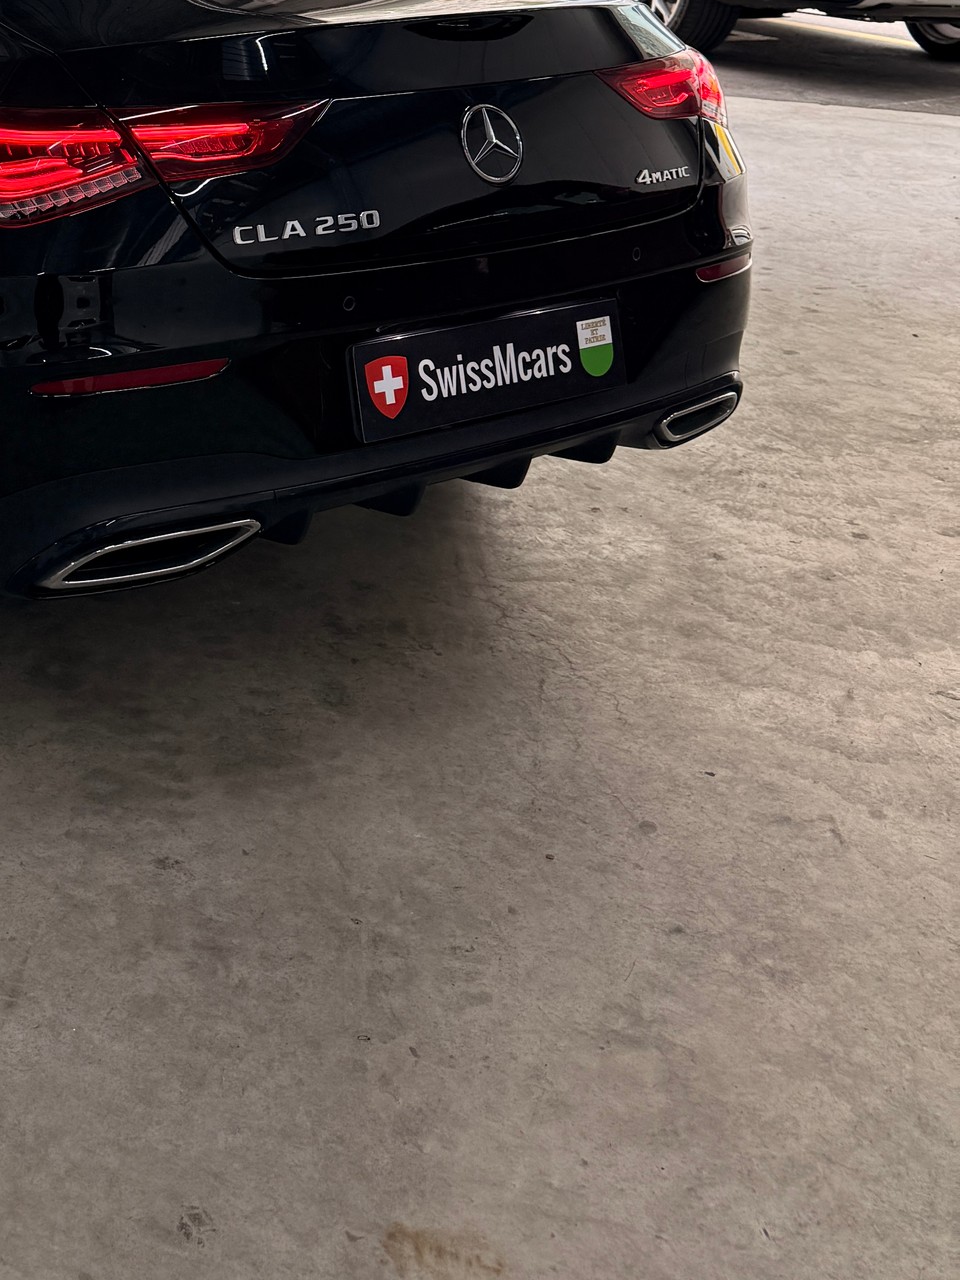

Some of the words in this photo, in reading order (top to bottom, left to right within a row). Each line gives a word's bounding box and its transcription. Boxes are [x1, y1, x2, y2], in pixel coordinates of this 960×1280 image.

[636, 166, 690, 185] 4MATIC
[233, 220, 306, 245] CLA
[315, 210, 381, 235] 250
[418, 342, 572, 402] SwissMcars
